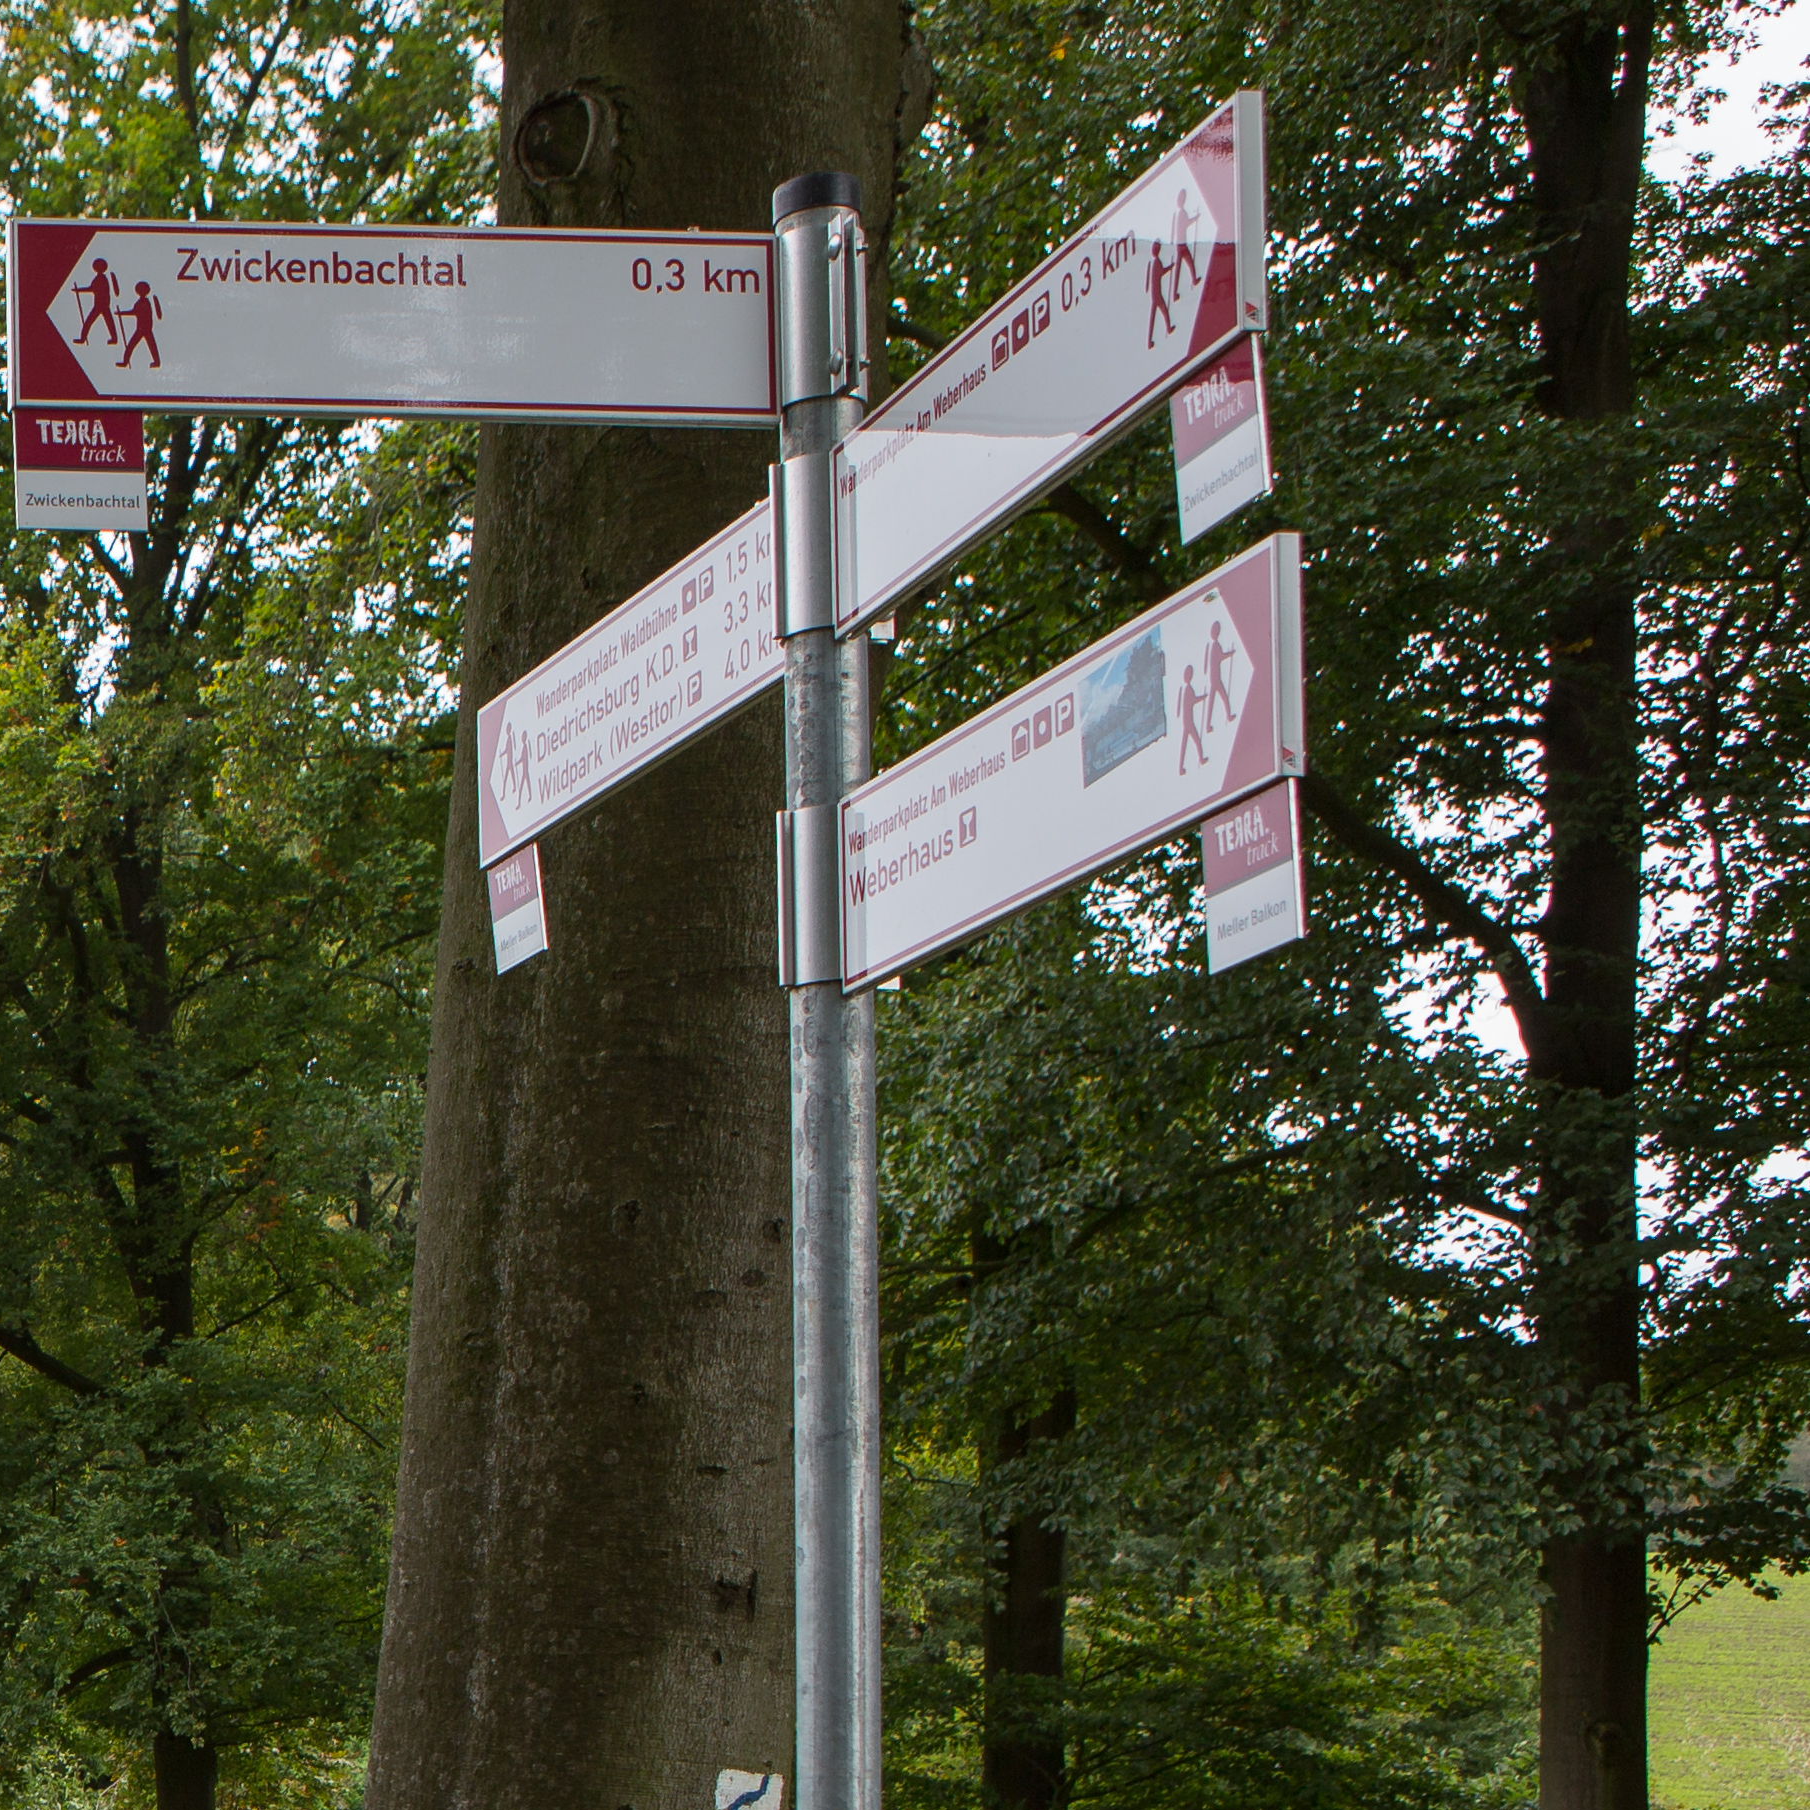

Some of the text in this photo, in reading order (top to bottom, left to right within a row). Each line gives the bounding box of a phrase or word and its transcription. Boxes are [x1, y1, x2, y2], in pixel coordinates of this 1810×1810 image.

[177, 248, 761, 295] Zwickenbachtal 0,3 km
[840, 230, 1135, 499] Wanderparkplatz Am Weberhaus 0,3 km
[1214, 394, 1244, 429] track
[81, 442, 127, 462] track
[1183, 447, 1258, 513] Zwickenbachtal
[25, 492, 141, 511] Zwickenbachtal
[536, 643, 618, 718] Wanderparkplatz
[620, 602, 678, 657] Waldbühne
[725, 539, 748, 586] 1,5
[536, 670, 640, 763] Diedrichsburg
[646, 643, 678, 686] K.D.
[723, 590, 749, 635] 3,3
[538, 740, 603, 805] Wildpark
[609, 687, 683, 760] (Westtor)
[723, 639, 750, 682] 4,0
[848, 749, 1006, 857] Wanderparkplatz Am Weberhaus
[850, 827, 954, 908] Weberhaus
[1246, 836, 1278, 867] track
[1217, 899, 1287, 942] Meller Balkon
